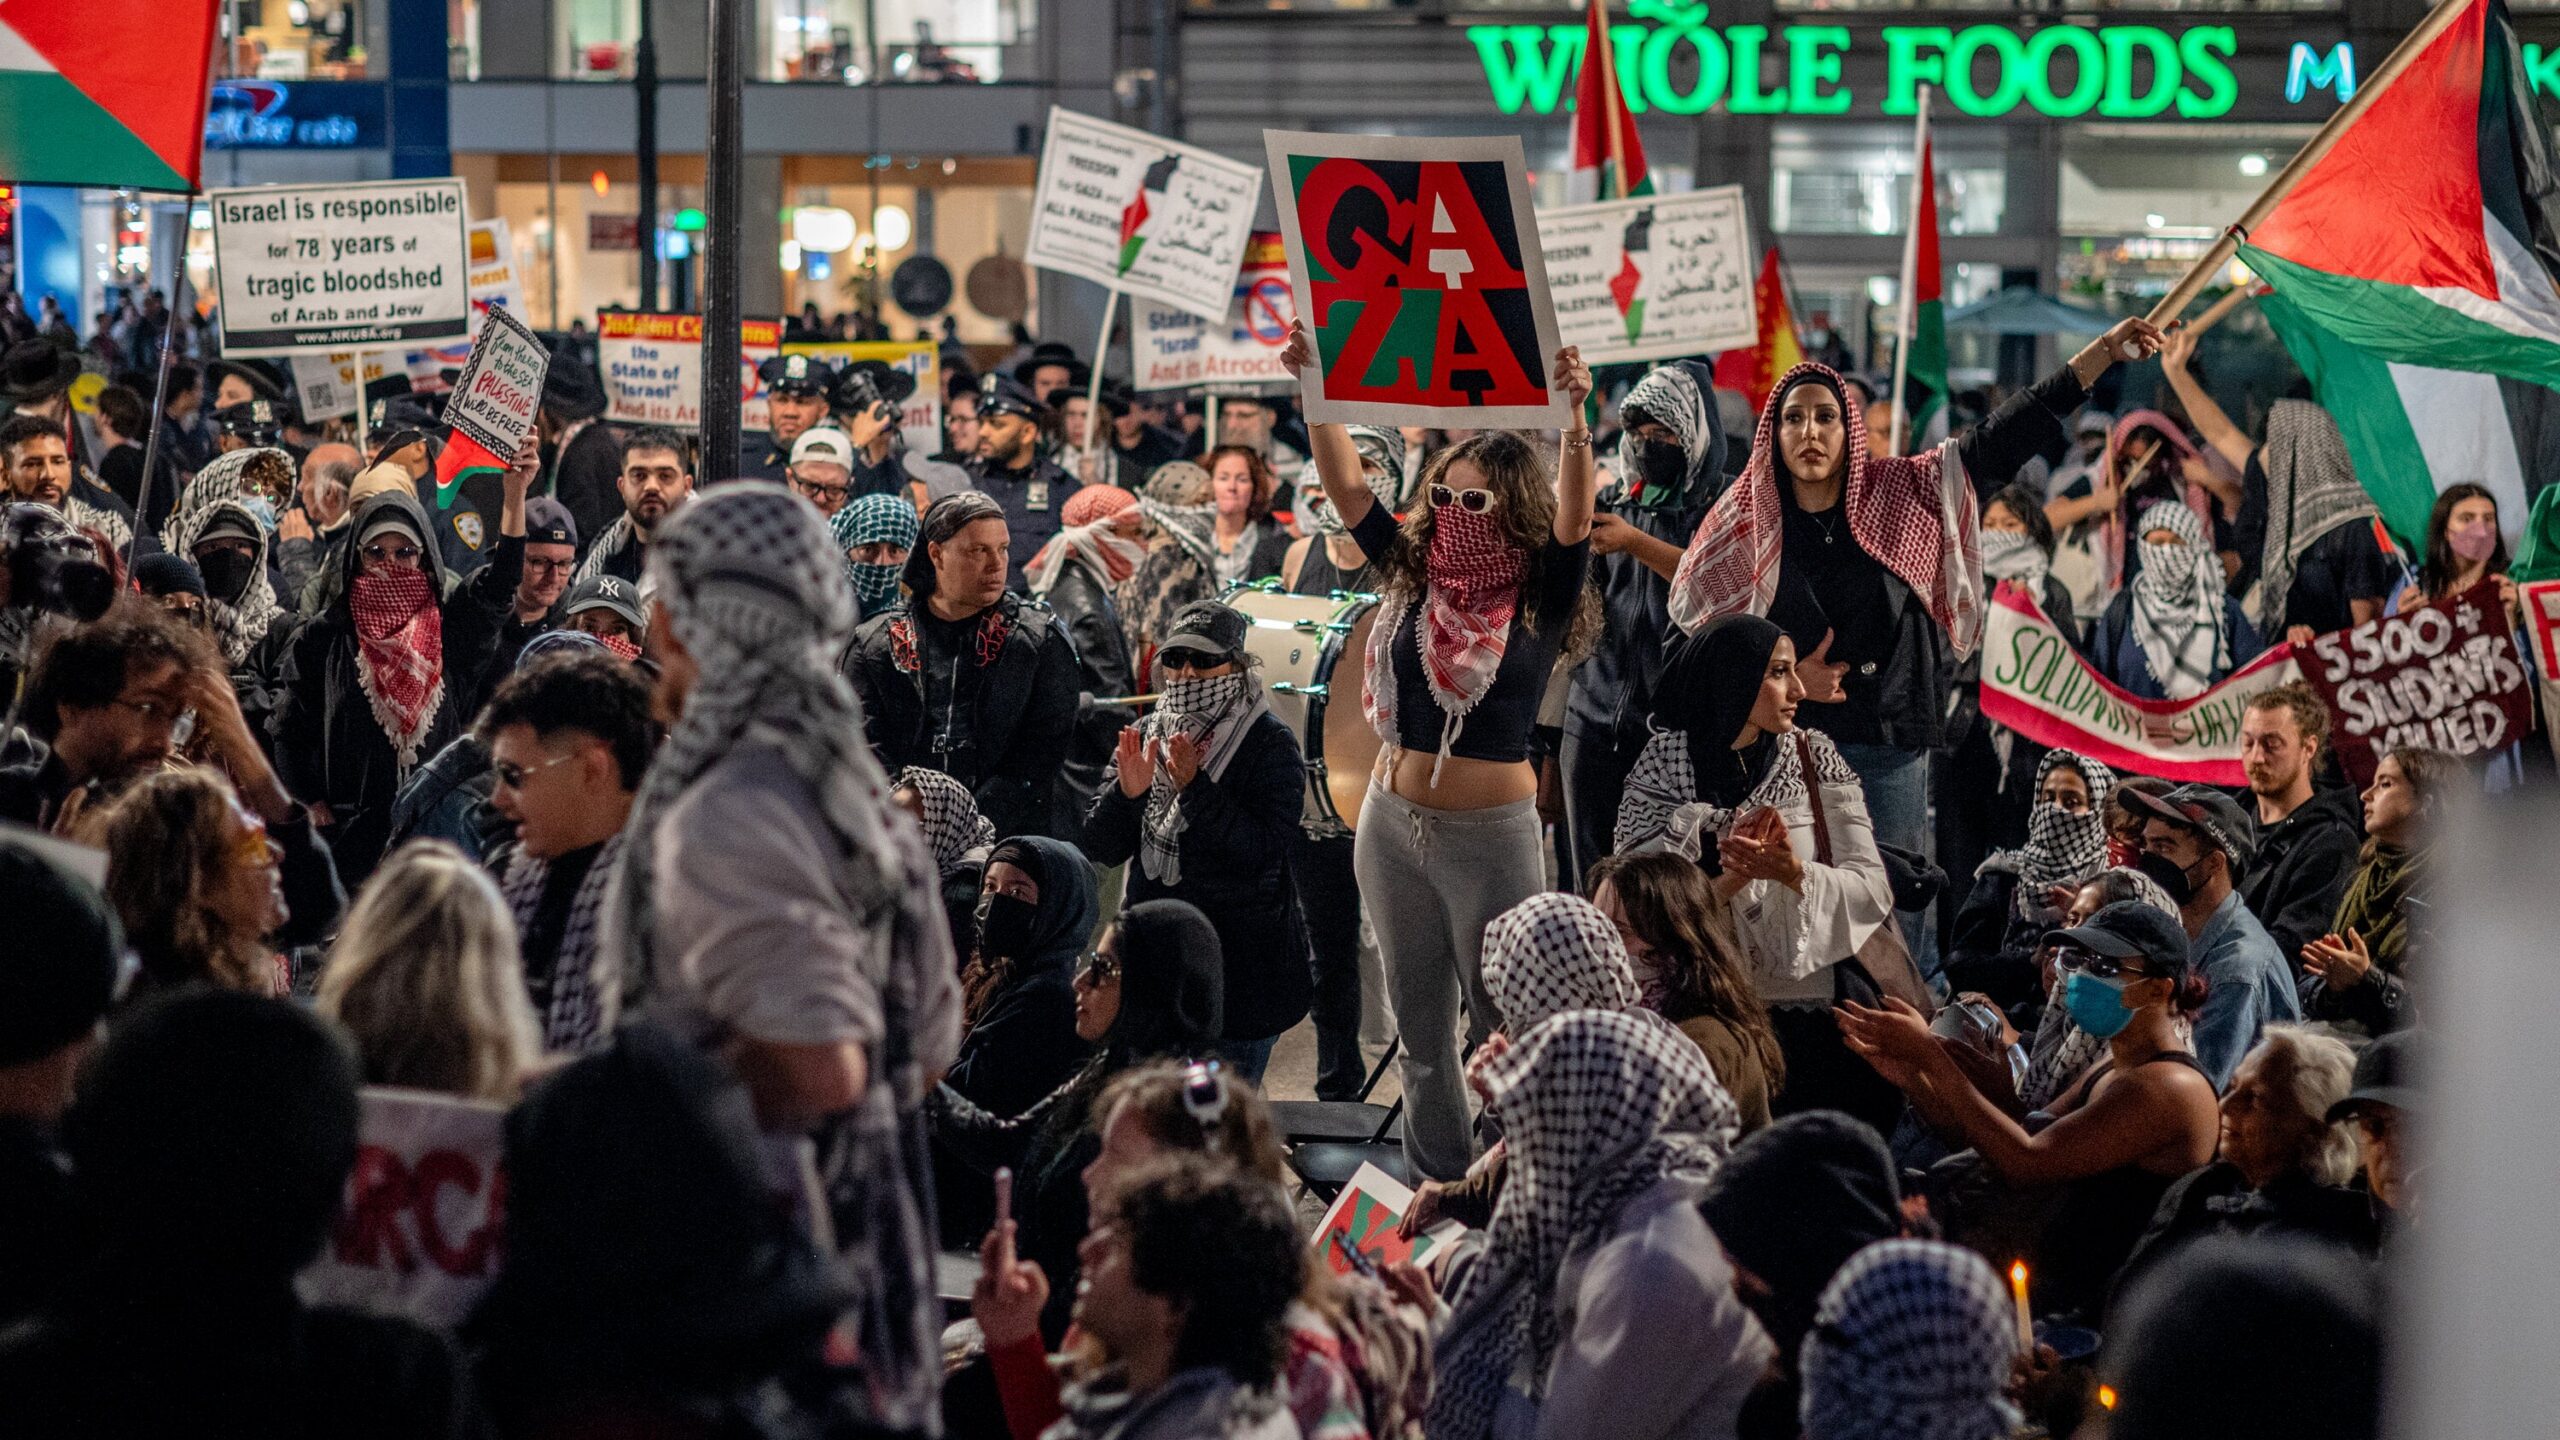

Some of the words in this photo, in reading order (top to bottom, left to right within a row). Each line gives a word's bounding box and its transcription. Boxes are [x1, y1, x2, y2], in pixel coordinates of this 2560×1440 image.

[1881, 24, 2239, 118] FOODS
[221, 198, 287, 223] Israel
[294, 198, 314, 219] is
[323, 191, 456, 223] responsible
[267, 244, 288, 258] for
[296, 238, 320, 258] 78
[332, 235, 395, 261] years
[403, 236, 417, 252] of
[247, 271, 316, 300] tragic
[323, 264, 443, 293] bloodshed
[271, 308, 288, 324] of
[295, 306, 338, 322] Arab
[345, 303, 379, 320] and
[385, 303, 423, 318] Jew
[295, 328, 402, 345] www.NKUSA.org
[631, 345, 659, 360] the
[611, 363, 658, 379] State
[662, 365, 680, 380] of
[475, 370, 535, 416] PALESTINE
[485, 408, 498, 424] BE
[496, 415, 527, 436] FREE
[614, 401, 646, 418] And
[598, 578, 620, 598] NY
[2336, 634, 2523, 735] STUDENTS
